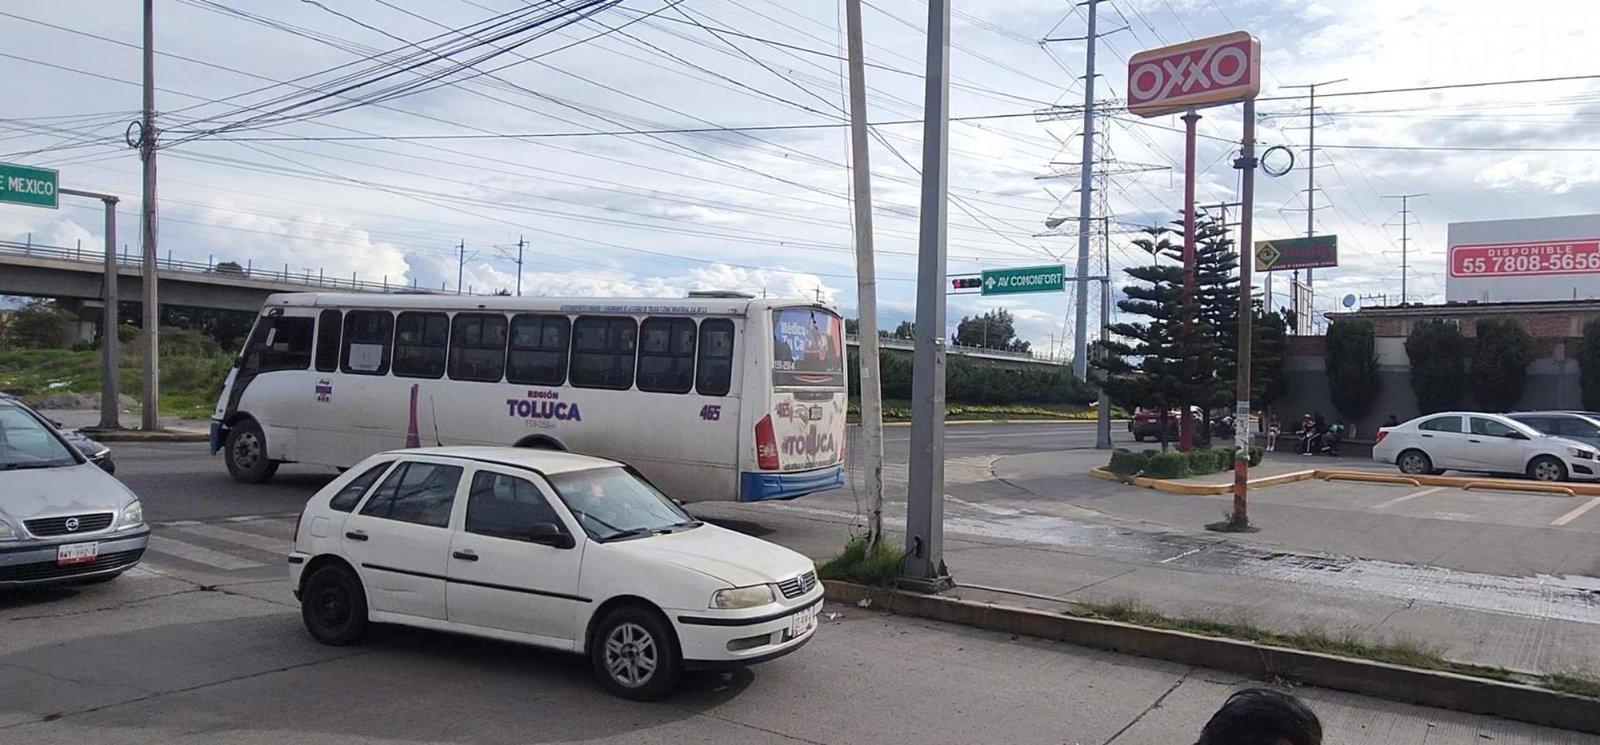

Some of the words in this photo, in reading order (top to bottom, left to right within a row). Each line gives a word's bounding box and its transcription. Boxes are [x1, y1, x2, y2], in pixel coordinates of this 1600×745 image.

[1130, 47, 1247, 100] OXXO
[8, 176, 54, 196] MEXICO
[1488, 246, 1573, 257] DISPONIBLE
[1463, 258, 1485, 273] 55
[1492, 253, 1600, 272] 7808-5656
[998, 276, 1009, 288] AV
[1010, 273, 1062, 286] COMONFORT
[528, 390, 558, 399] REGIÓN
[507, 399, 581, 421] TOLUCA
[700, 404, 721, 420] 465
